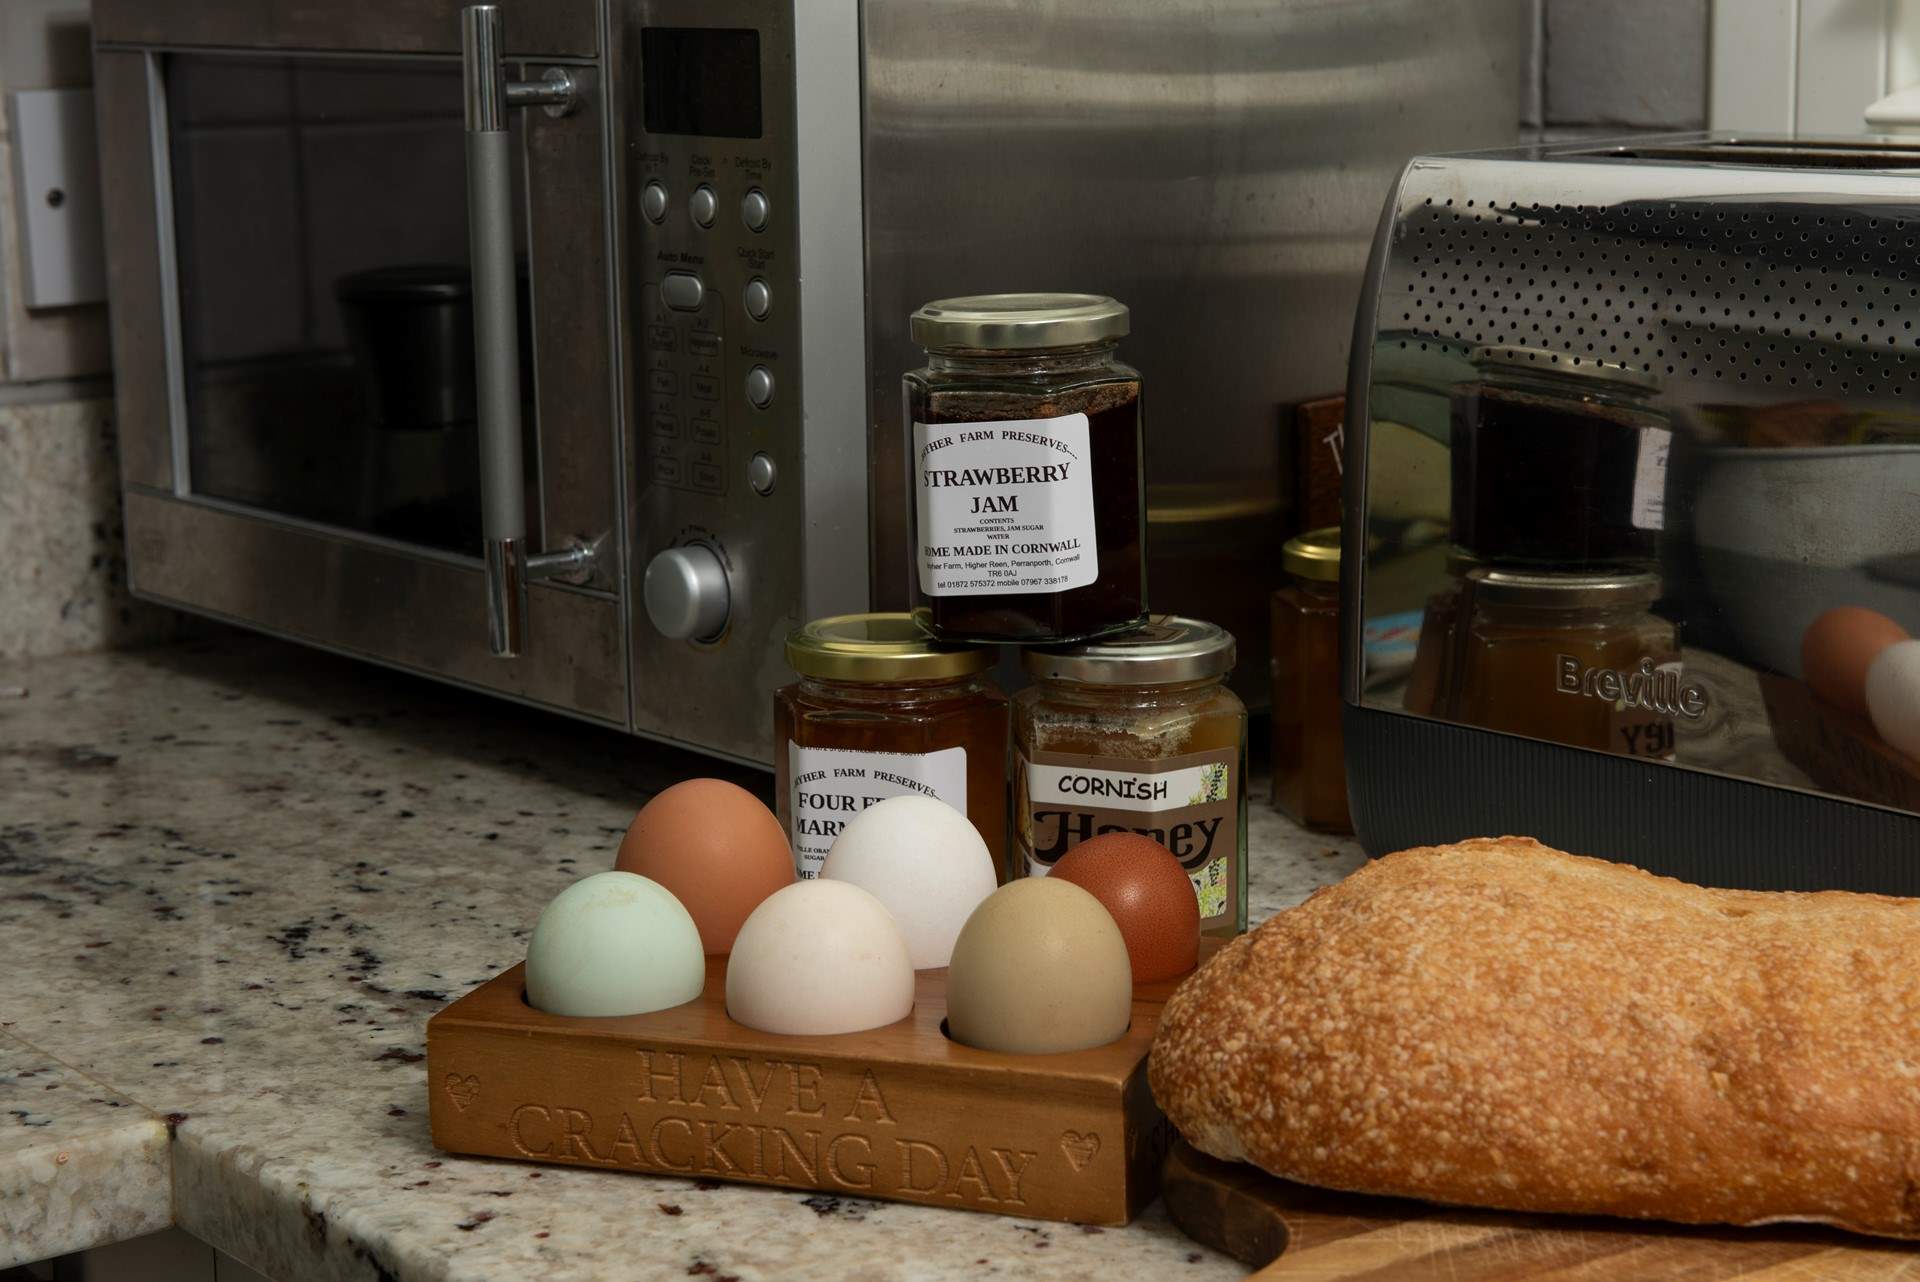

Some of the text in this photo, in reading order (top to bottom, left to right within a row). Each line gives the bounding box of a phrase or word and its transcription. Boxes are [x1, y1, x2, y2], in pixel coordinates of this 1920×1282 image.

[960, 430, 994, 443] FARM
[924, 462, 1070, 488] STRAWBERRY
[970, 495, 1019, 514] JAM
[954, 545, 991, 557] MADE
[995, 544, 1009, 556] IN
[1012, 538, 1081, 555] CORNWALL
[943, 561, 964, 570] Farm,
[965, 560, 988, 570] Higher
[1055, 553, 1081, 566] Cornwall
[996, 578, 1020, 587] mobile
[1020, 578, 1043, 586] 07967
[1554, 653, 1709, 719] Breville
[834, 768, 866, 778] FARM
[1058, 774, 1168, 801] CORNISH
[798, 792, 857, 812] FOUR
[638, 1050, 898, 1124] HAVE A
[508, 1103, 1039, 1206] CRACKING DAY
